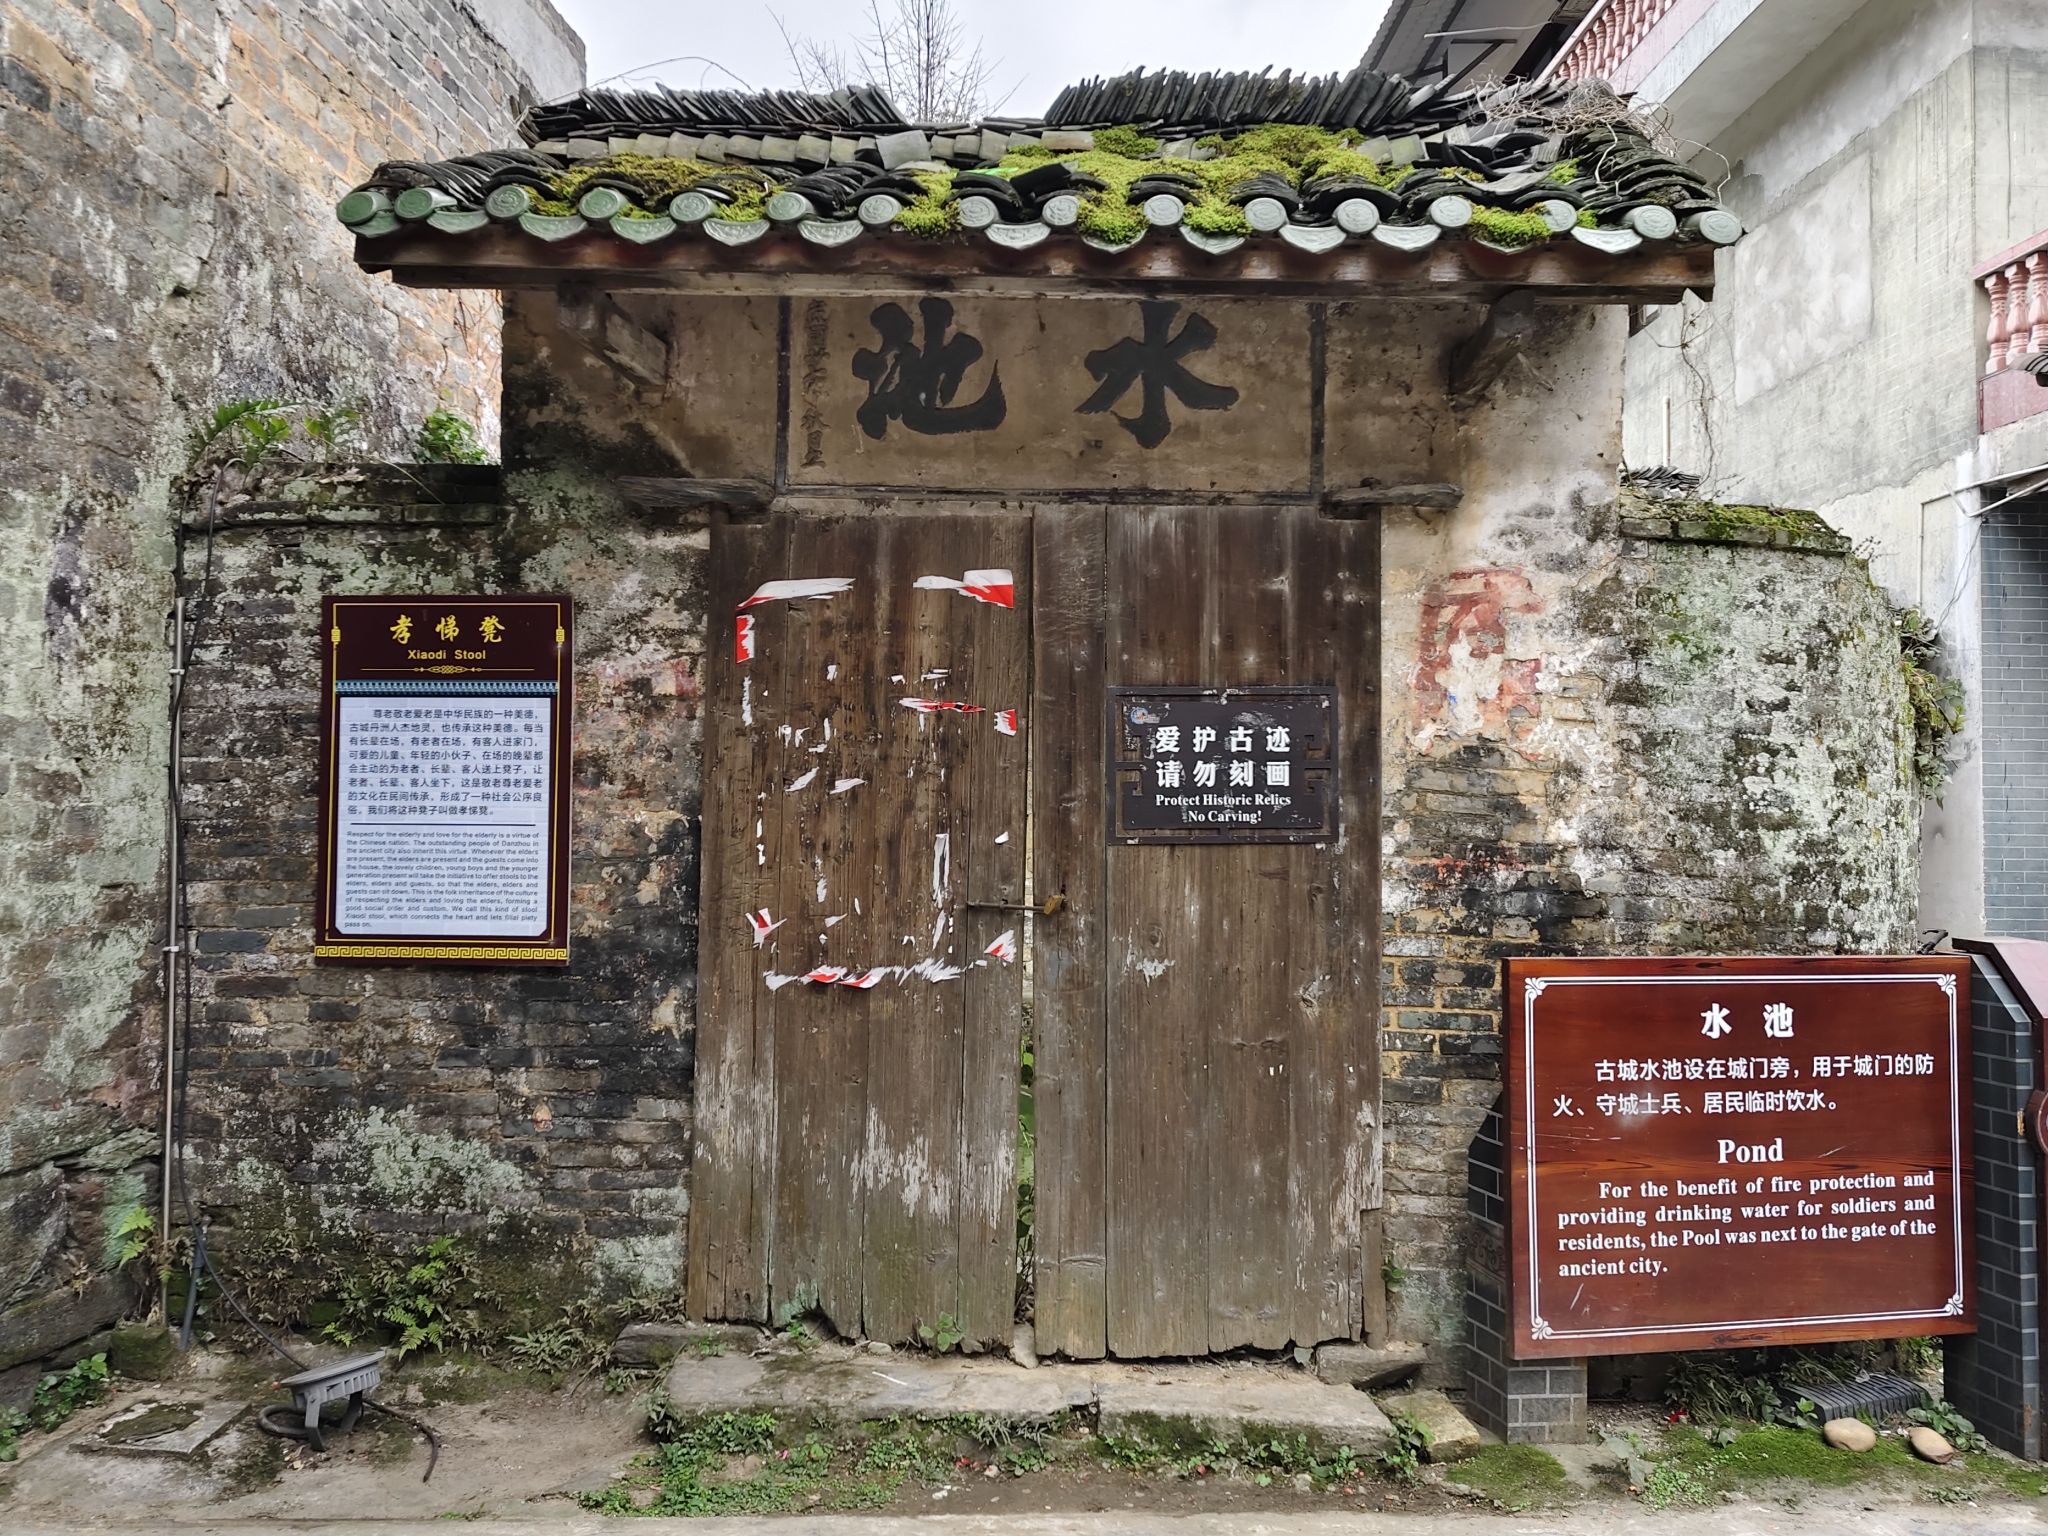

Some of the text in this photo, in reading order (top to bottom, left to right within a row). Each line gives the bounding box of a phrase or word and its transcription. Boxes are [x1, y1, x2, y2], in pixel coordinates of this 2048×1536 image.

[408, 650, 486, 660] Xiaodi Stool
[1156, 726, 1290, 753] 爱护古迹
[1156, 760, 1290, 787] 请勿刻画
[1156, 794, 1291, 805] Protect Historic Relics
[1188, 810, 1262, 825] No Carving!
[1700, 1003, 1795, 1038] 水池
[1595, 1054, 1935, 1082] 古城水池设在城门旁，用于城门的防
[1552, 1093, 1838, 1118] 火、守城士兵、居民临时饮水。
[1717, 1138, 1784, 1163] Pond
[1599, 1171, 1934, 1199] For the benefit of fire protection and
[1558, 1196, 1935, 1229] providing drinking water for soldiers and
[1558, 1220, 1936, 1252] residents, the Pool was next to the gate of the
[1559, 1258, 1668, 1276] ancient city.
